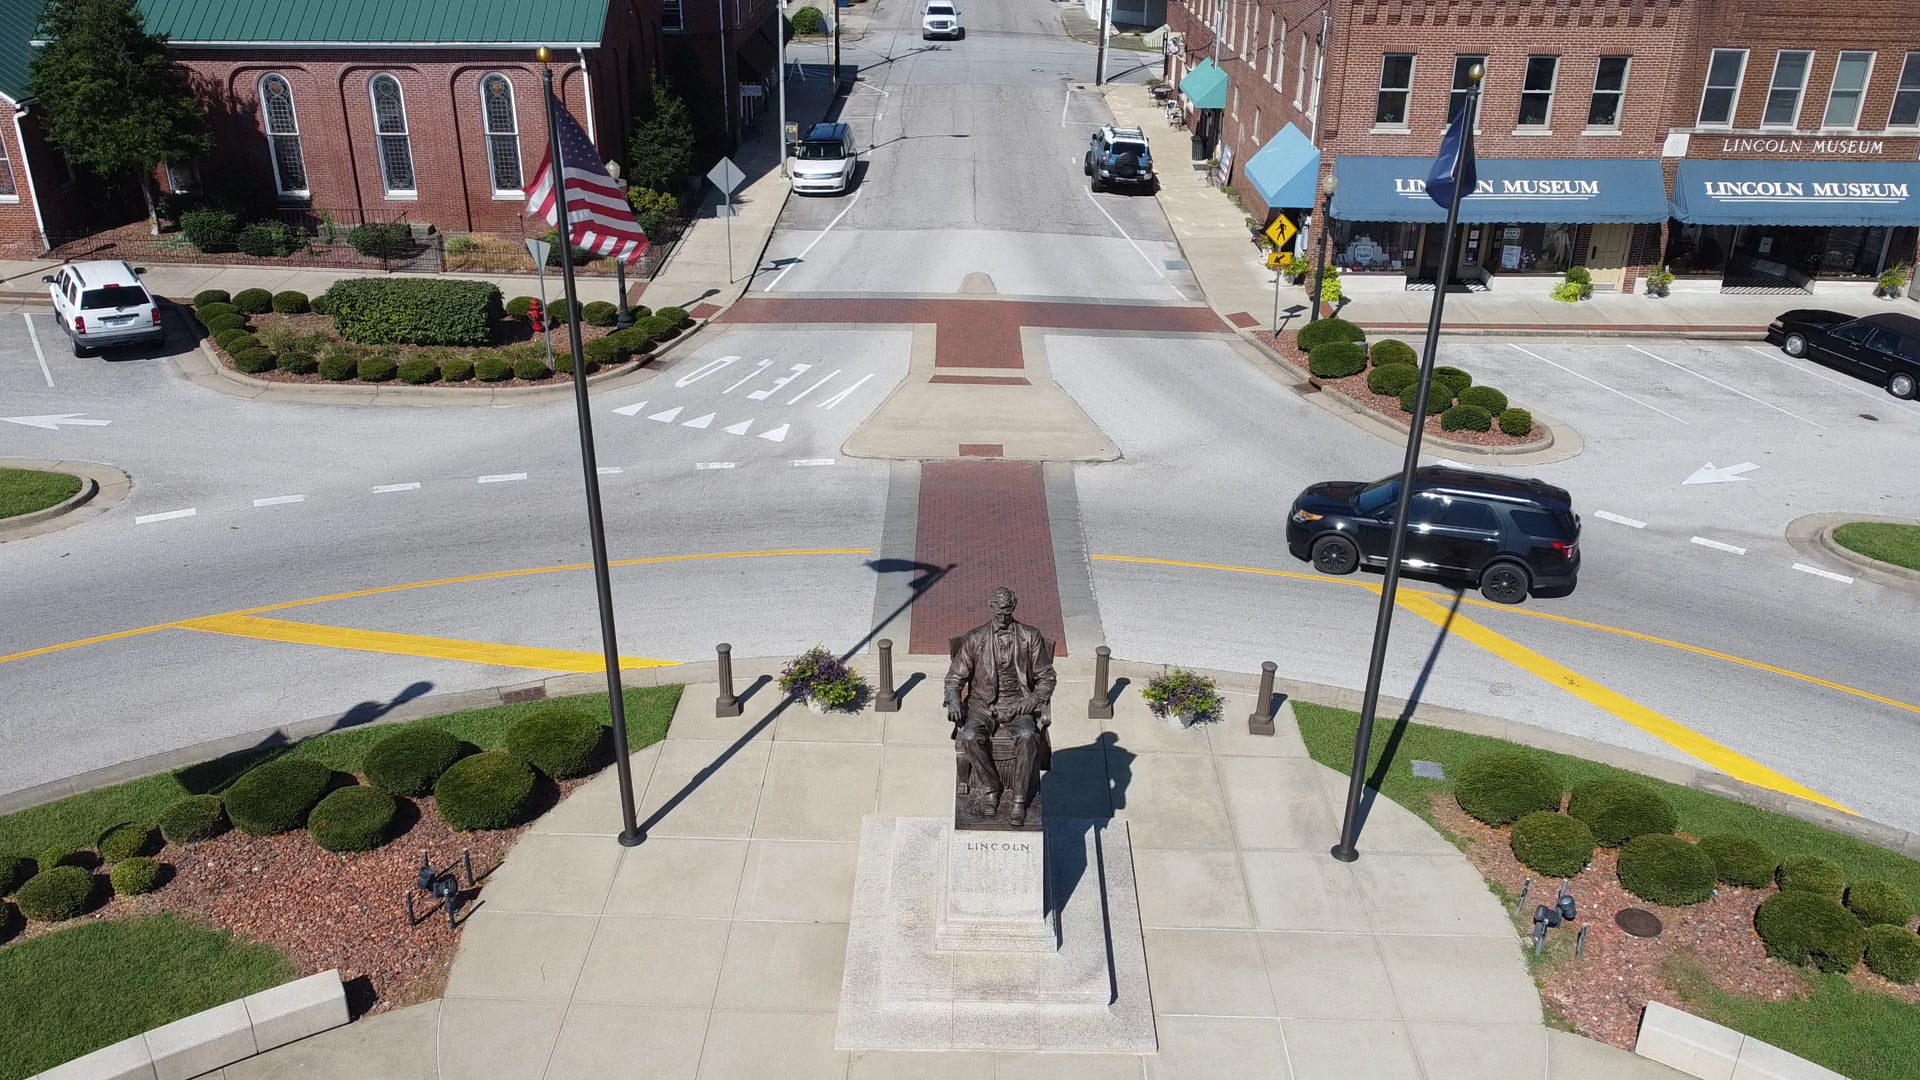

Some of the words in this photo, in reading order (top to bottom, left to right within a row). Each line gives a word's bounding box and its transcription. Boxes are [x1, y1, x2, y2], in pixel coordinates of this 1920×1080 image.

[1722, 139, 1803, 153] LINCOLN
[1811, 140, 1885, 154] MUSEUM
[1394, 178, 1495, 194] LINN
[1502, 179, 1600, 194] MUSEUM
[1704, 181, 1804, 197] LINCOLN
[1811, 182, 1911, 198] MUSEUM
[675, 355, 875, 410] YIELD
[967, 842, 1030, 852] LINCOLN
